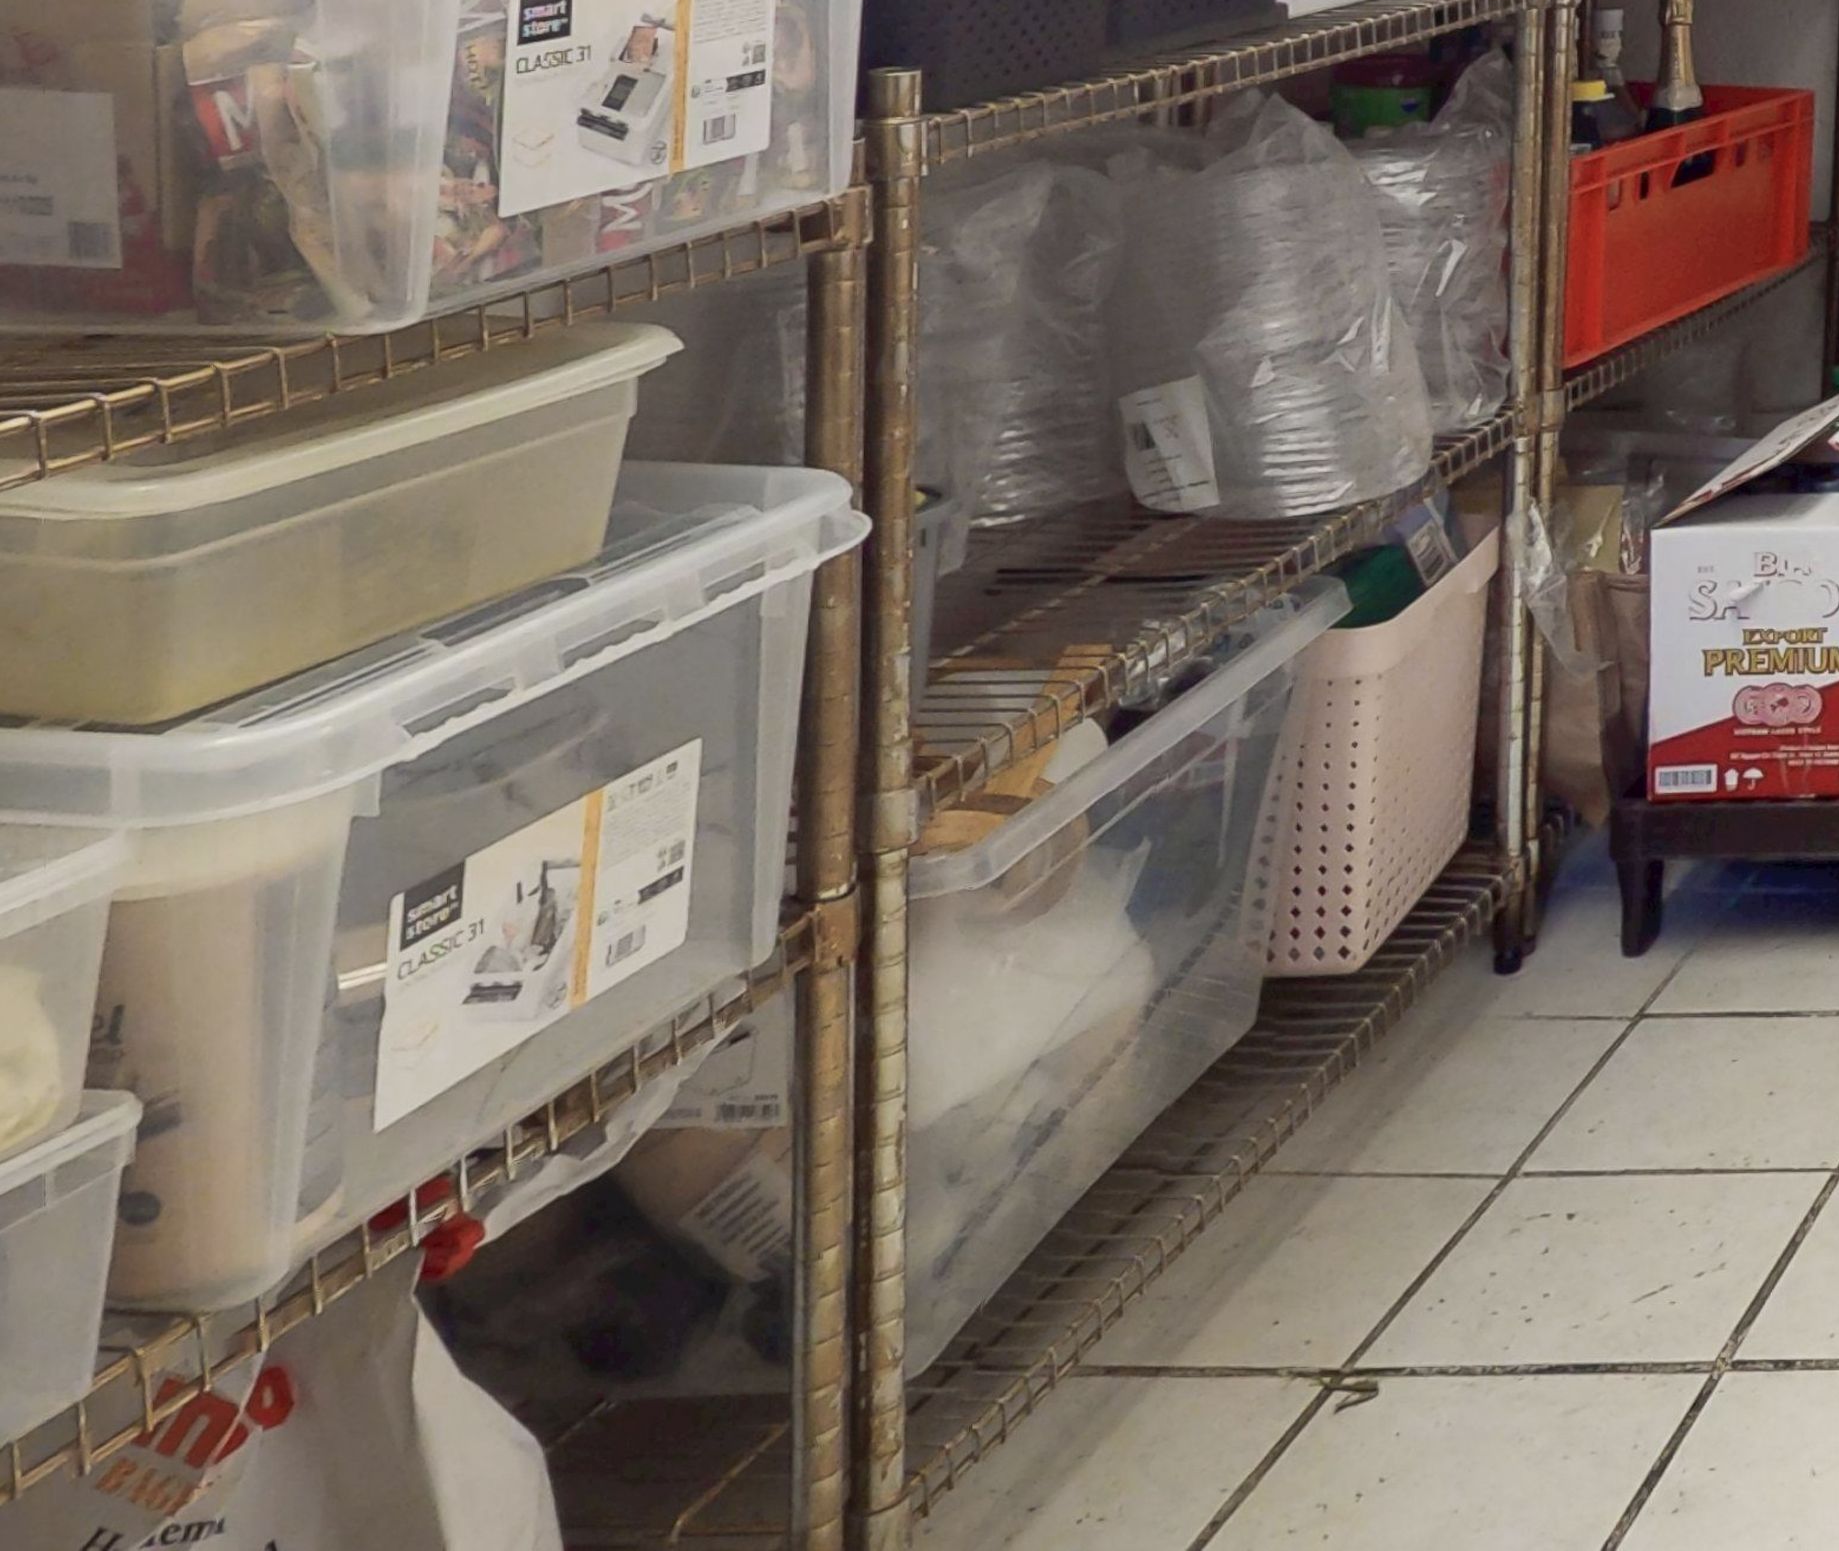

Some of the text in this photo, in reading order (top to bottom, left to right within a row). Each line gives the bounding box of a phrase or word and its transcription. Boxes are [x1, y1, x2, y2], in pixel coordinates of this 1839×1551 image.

[523, 0, 568, 21] smart
[516, 45, 592, 74] CLASSIC 31
[1742, 627, 1828, 646] EXPORT
[397, 918, 486, 980] CLASSIC 31
